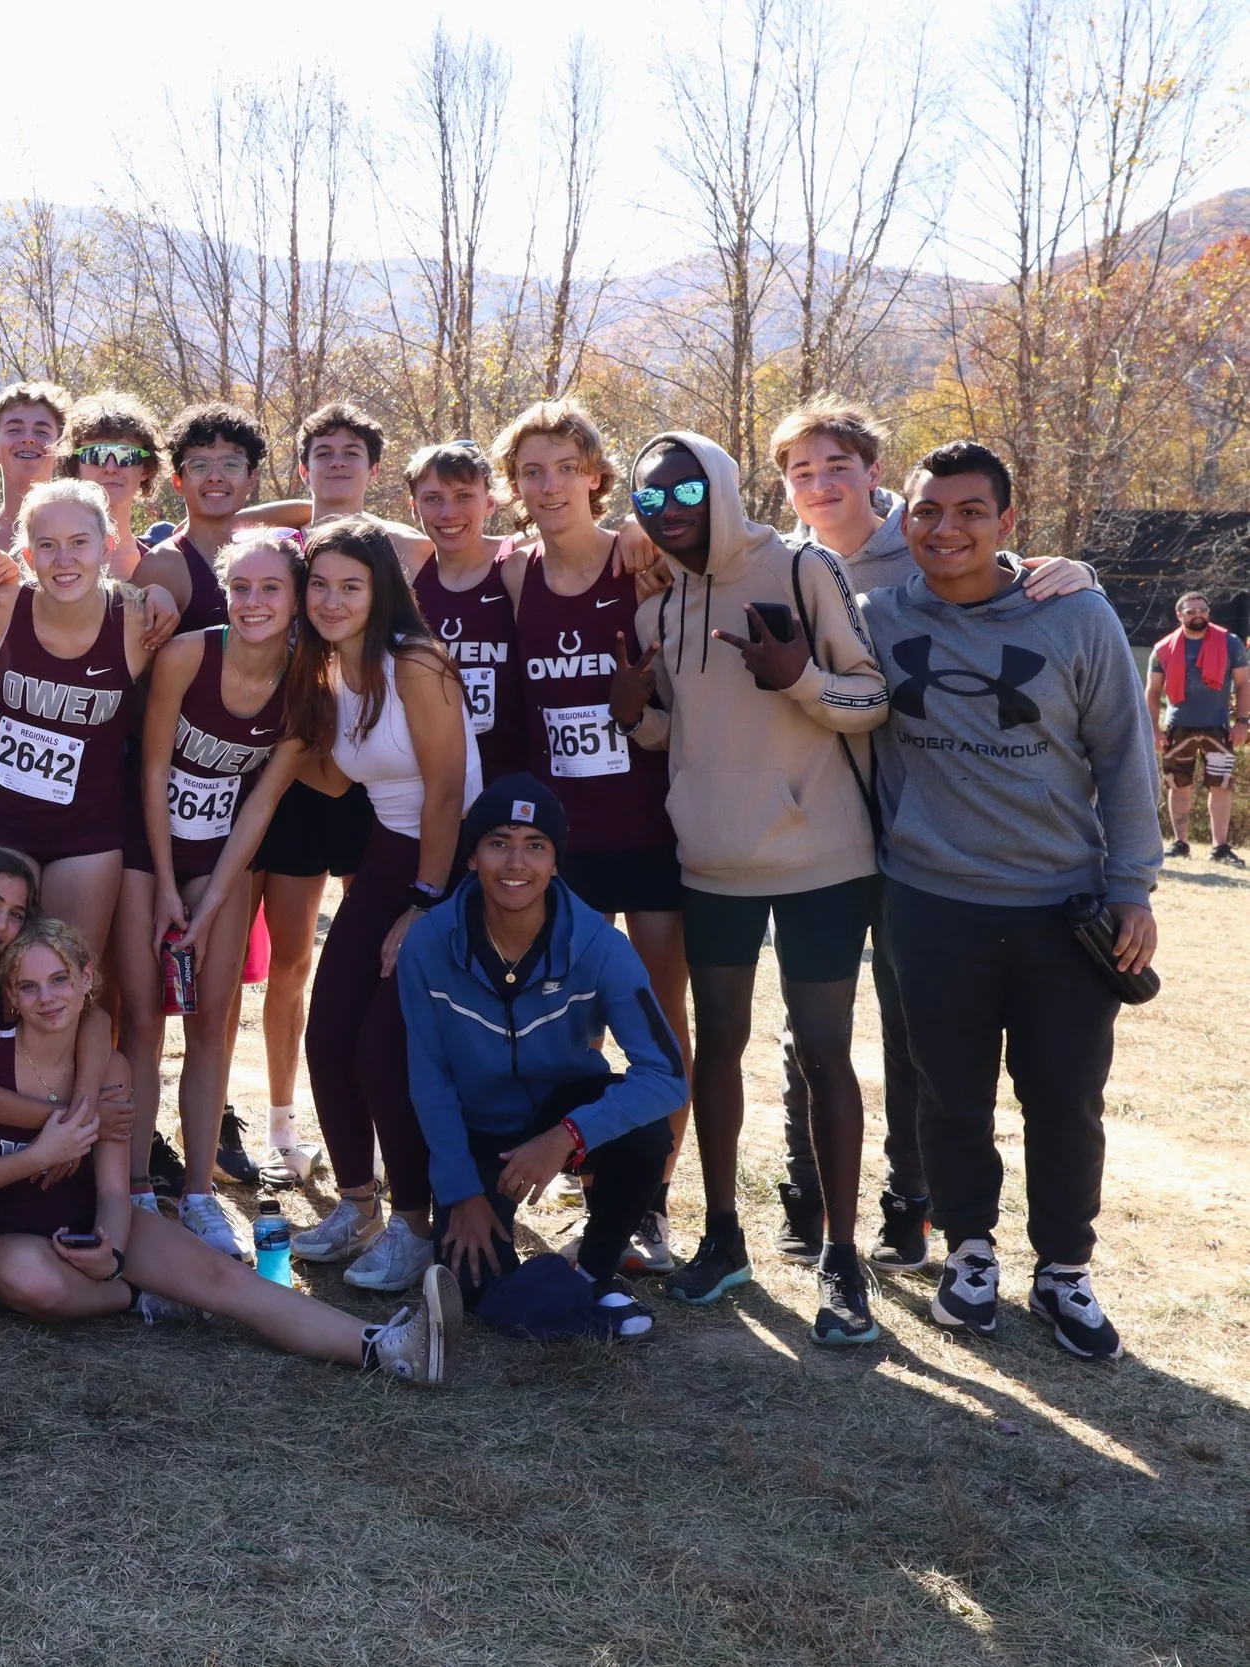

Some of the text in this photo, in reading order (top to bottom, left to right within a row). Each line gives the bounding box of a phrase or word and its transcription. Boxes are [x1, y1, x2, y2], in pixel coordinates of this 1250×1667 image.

[2, 669, 123, 726] OWEN
[557, 710, 597, 721] REGIONALS
[20, 728, 59, 746] REGIONALS
[548, 719, 618, 757] 2651
[896, 730, 1049, 759] UNDER ARMOUR
[183, 777, 220, 790] REGIONALS
[167, 782, 234, 822] 2643
